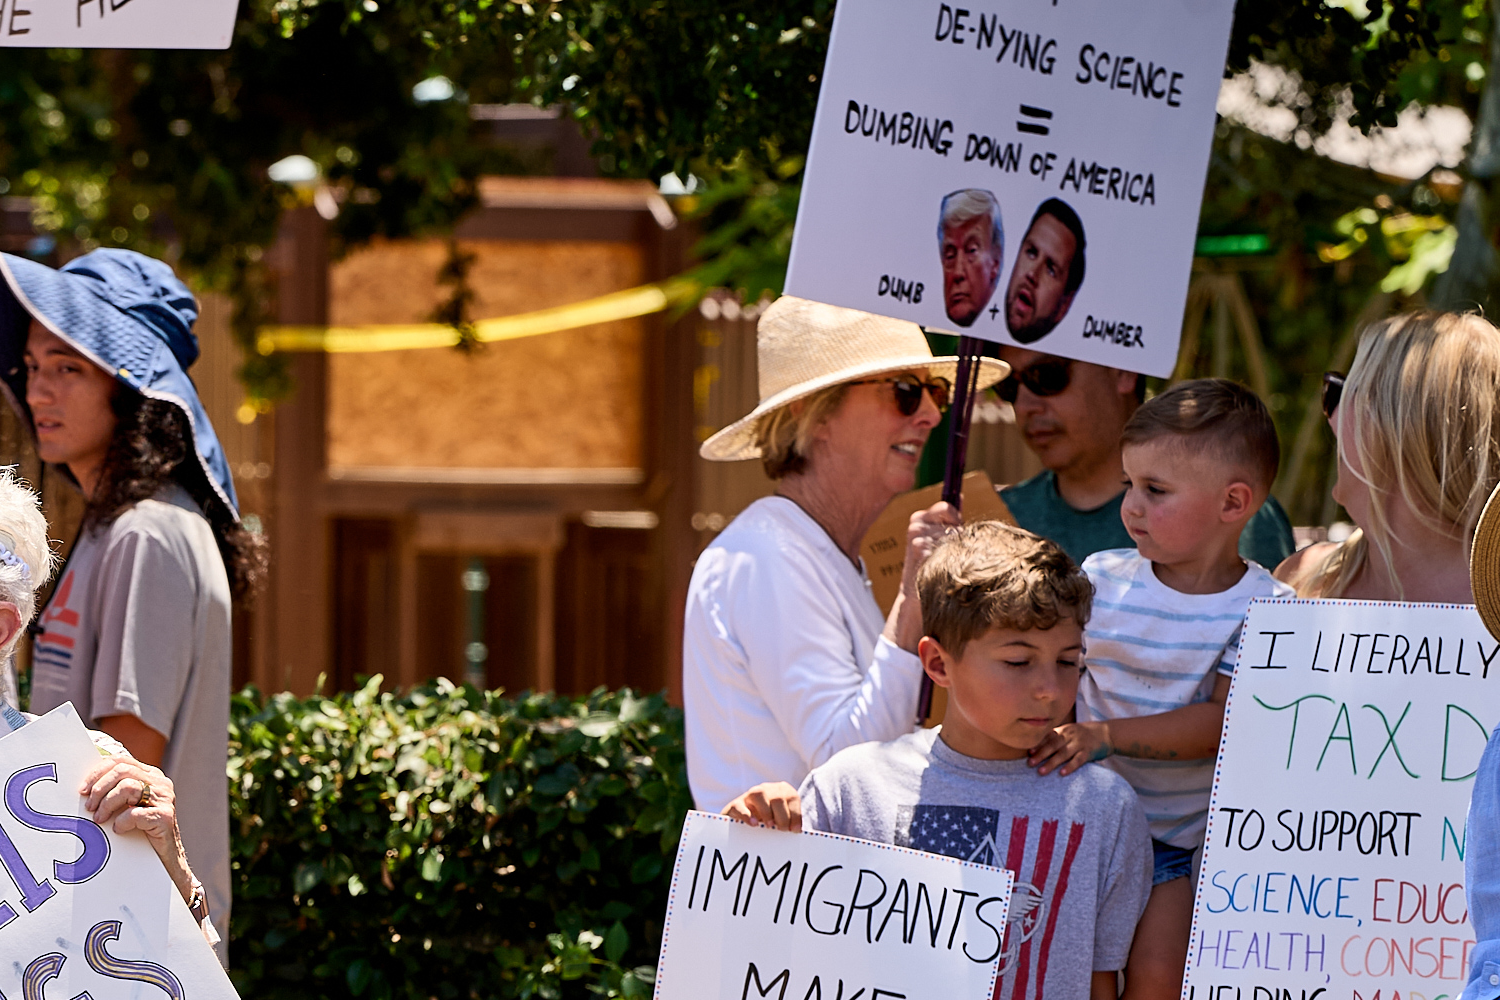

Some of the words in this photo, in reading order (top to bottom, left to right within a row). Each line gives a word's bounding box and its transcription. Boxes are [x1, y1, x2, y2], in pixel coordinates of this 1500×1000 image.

[935, 3, 1057, 75] DE-NYING
[1076, 44, 1183, 107] SCIENCE
[844, 100, 953, 156] DUMBING
[964, 133, 1022, 173] DOWN
[1030, 152, 1057, 182] OF
[1060, 158, 1156, 206] AMERICA
[877, 274, 924, 304] DUMB
[1083, 315, 1144, 348] DUMBER
[1250, 631, 1295, 670] I
[1311, 630, 1500, 679] LITERALLY
[1253, 694, 1420, 780] TAX
[1219, 807, 1265, 851] TO
[1271, 808, 1421, 857] SUPPORT
[688, 845, 1003, 964] IMMIGRANTS
[1206, 870, 1363, 928] SCIENCE,
[1196, 929, 1331, 983] HEALTH,
